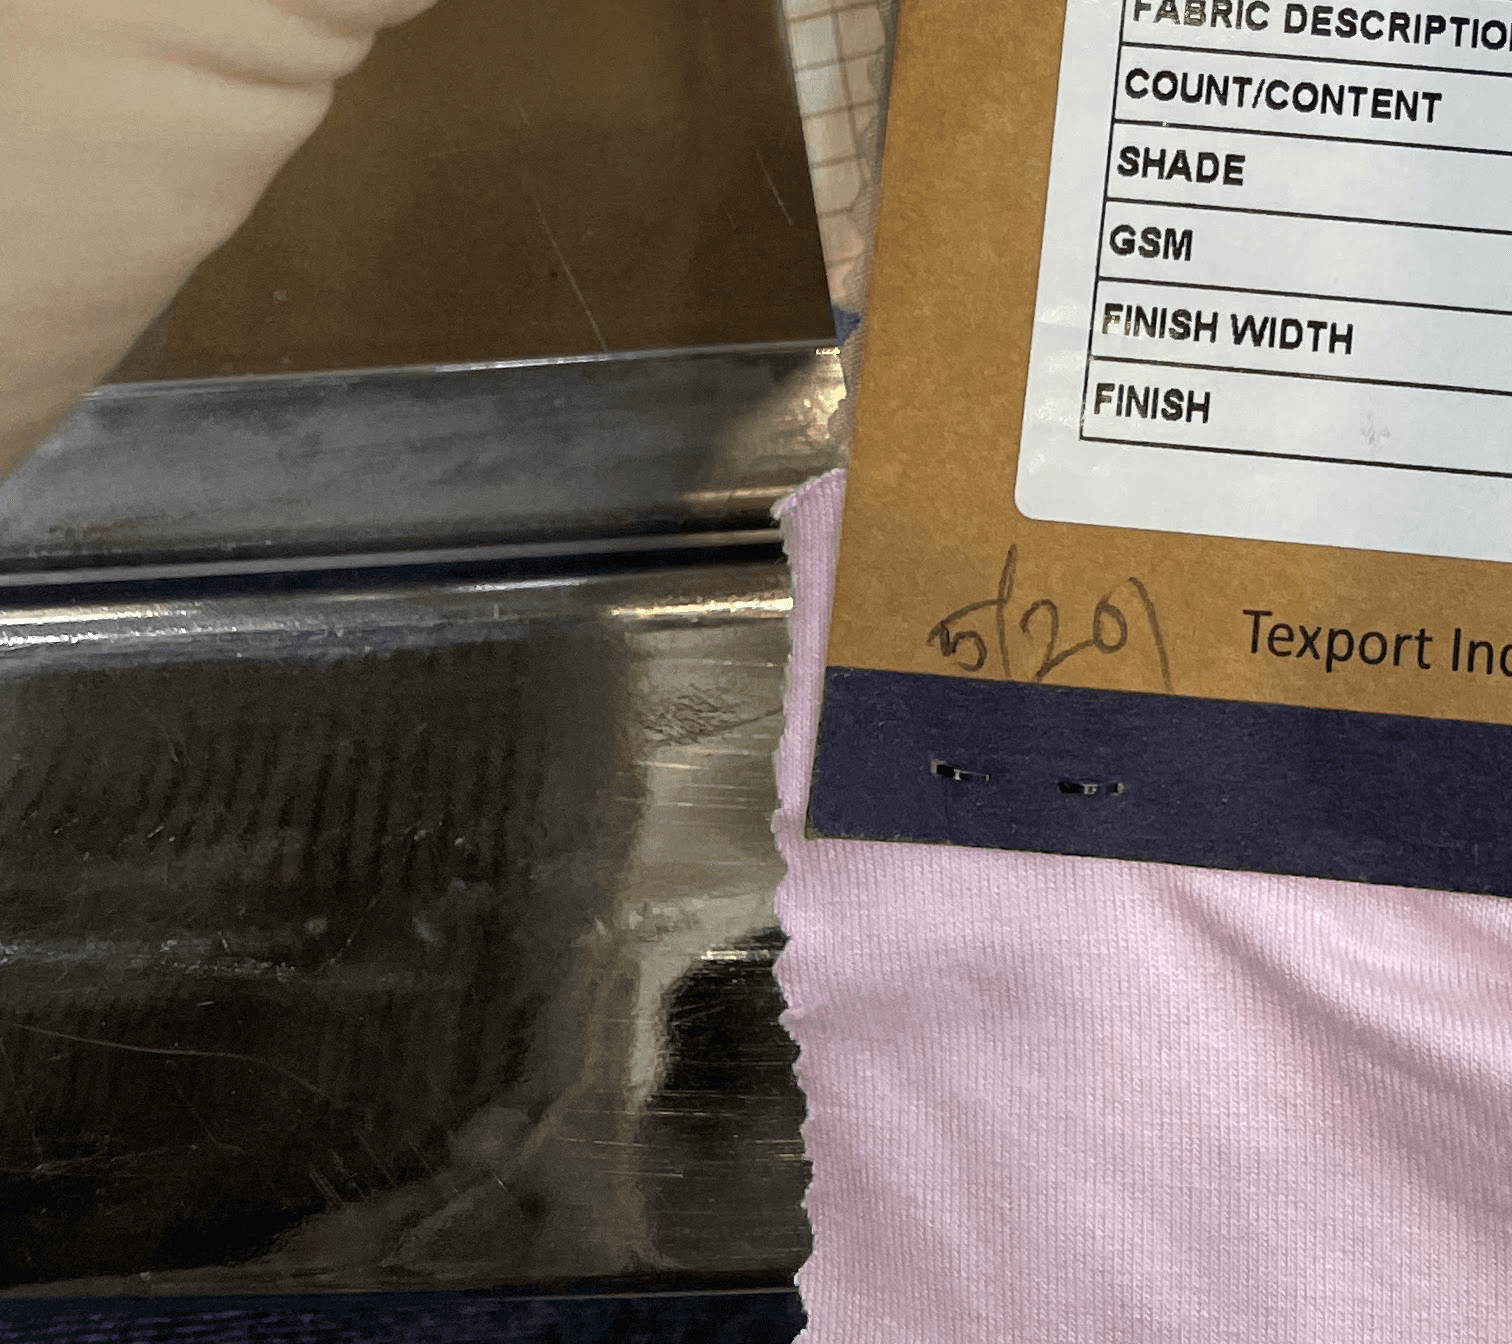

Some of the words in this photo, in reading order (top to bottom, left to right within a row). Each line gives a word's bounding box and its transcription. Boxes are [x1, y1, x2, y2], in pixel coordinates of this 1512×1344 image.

[1125, 68, 1442, 123] COUNT/CONTENT
[1117, 146, 1245, 186] SHADE
[1110, 225, 1193, 261] GSM
[1102, 303, 1218, 343] FINISH
[1231, 314, 1353, 354] WIDTH
[1094, 383, 1210, 423] FINISH
[1243, 610, 1432, 673] Texport
